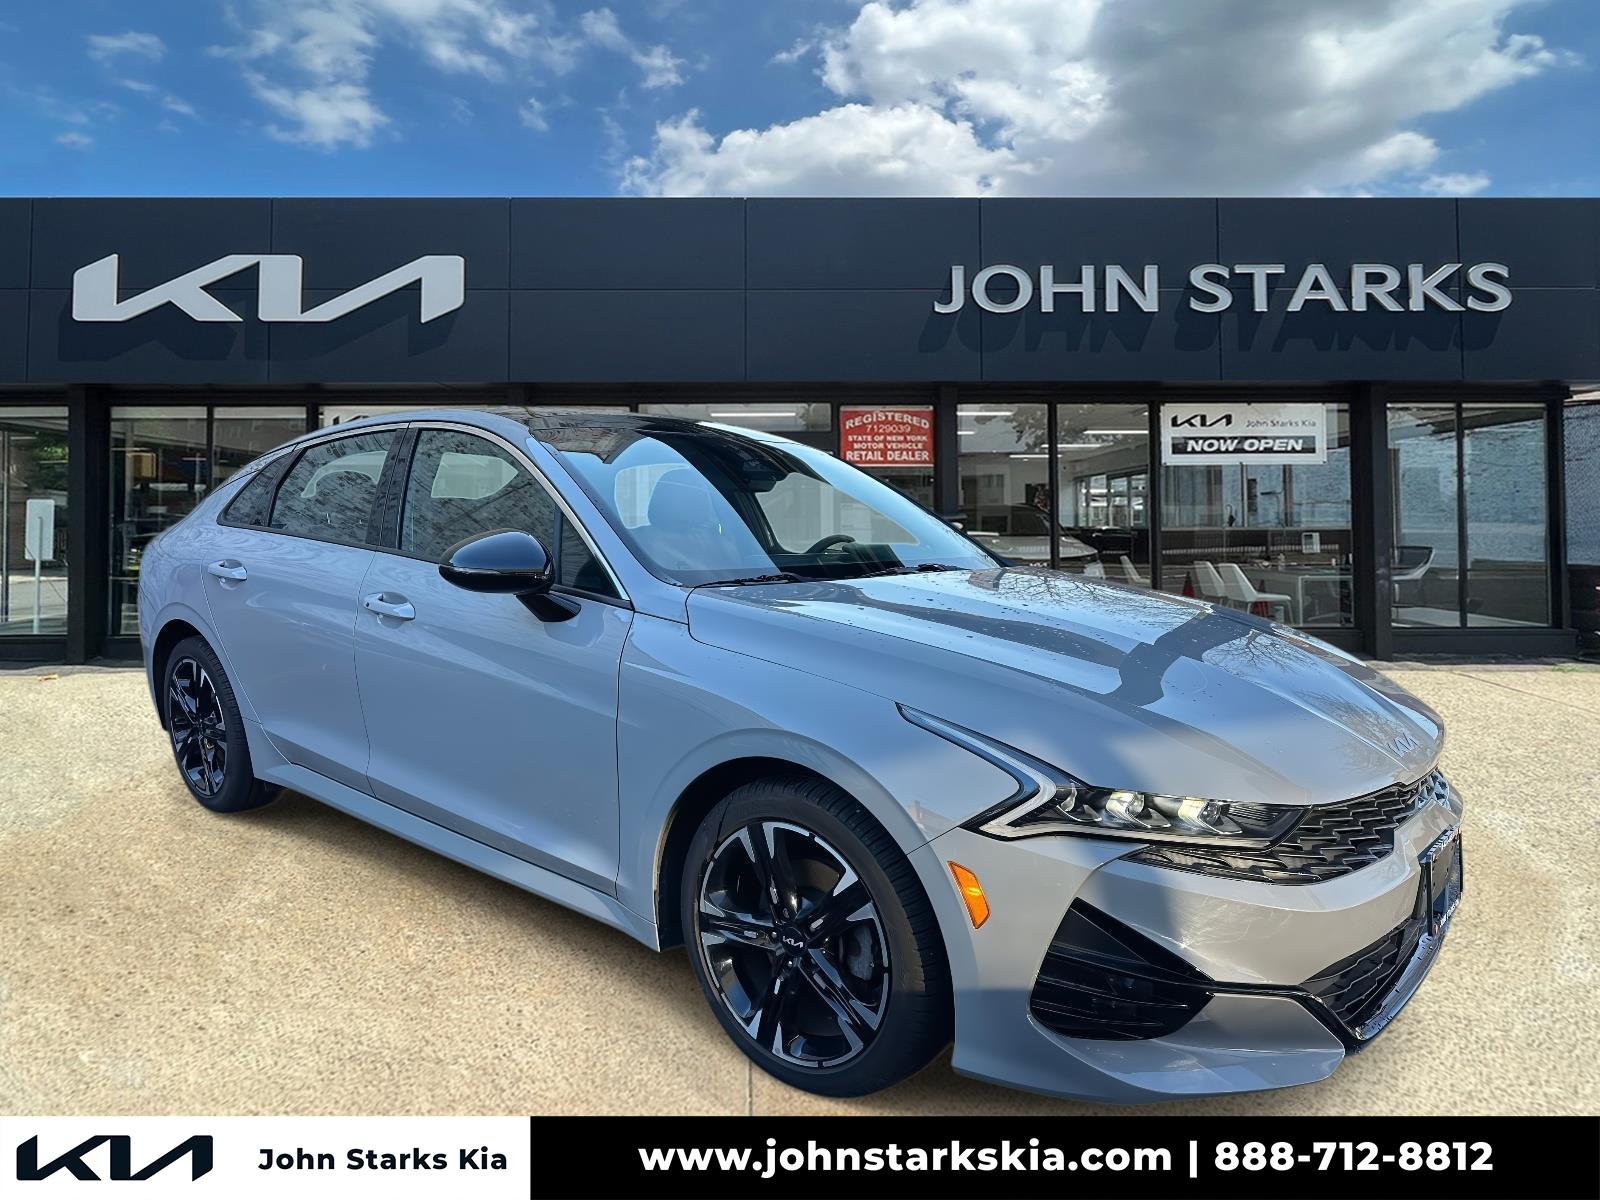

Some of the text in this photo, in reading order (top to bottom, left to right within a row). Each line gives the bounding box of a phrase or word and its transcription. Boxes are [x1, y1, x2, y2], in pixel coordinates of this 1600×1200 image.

[934, 262, 1513, 314] JOHN STARKS
[845, 411, 930, 430] REGISTERED
[1246, 419, 1316, 427] John Starks Kia
[866, 424, 911, 433] 7129039
[1186, 439, 1303, 452] NOW OPEN
[846, 451, 929, 461] RETAIL DEALER
